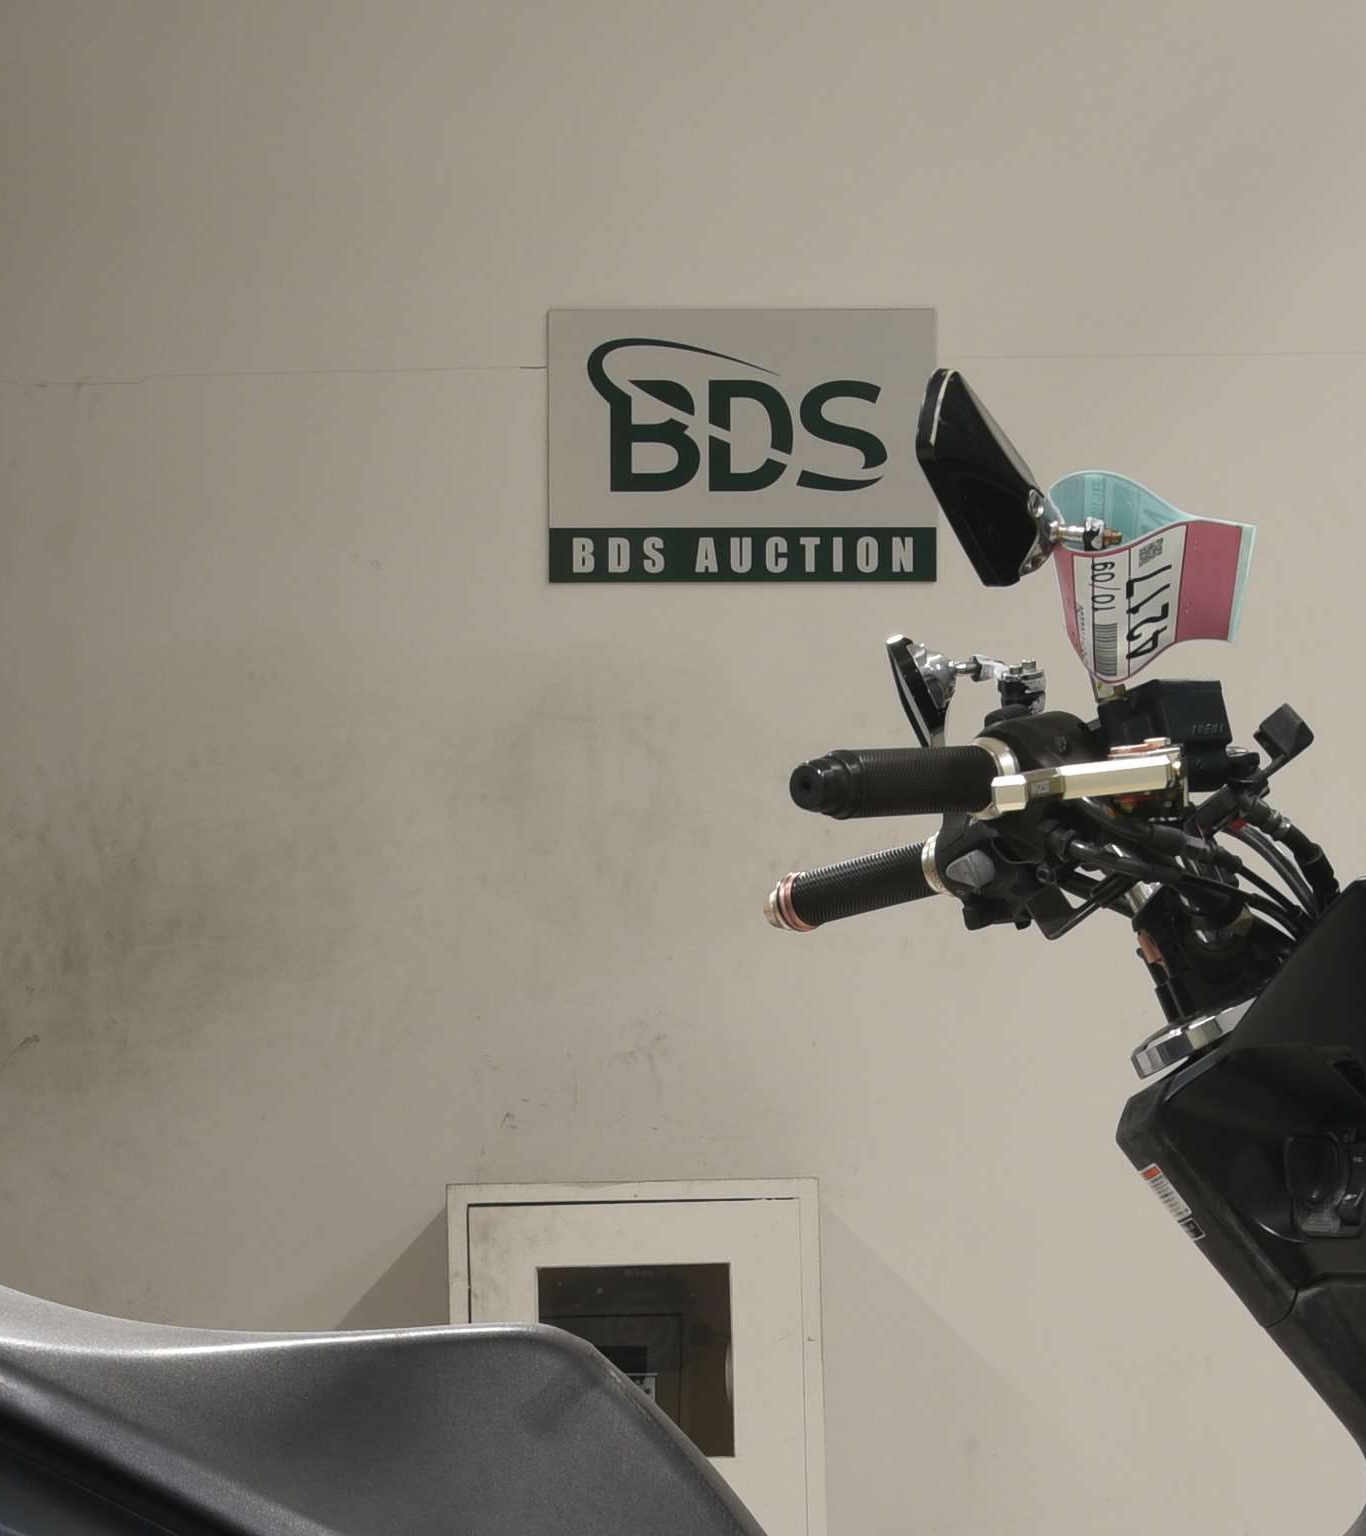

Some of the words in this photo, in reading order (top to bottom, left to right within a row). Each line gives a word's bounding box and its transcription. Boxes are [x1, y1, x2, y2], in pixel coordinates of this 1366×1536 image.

[587, 338, 888, 492] BDS
[572, 536, 666, 574] BDS
[695, 535, 915, 574] AUCTION
[1126, 564, 1173, 660] 4217
